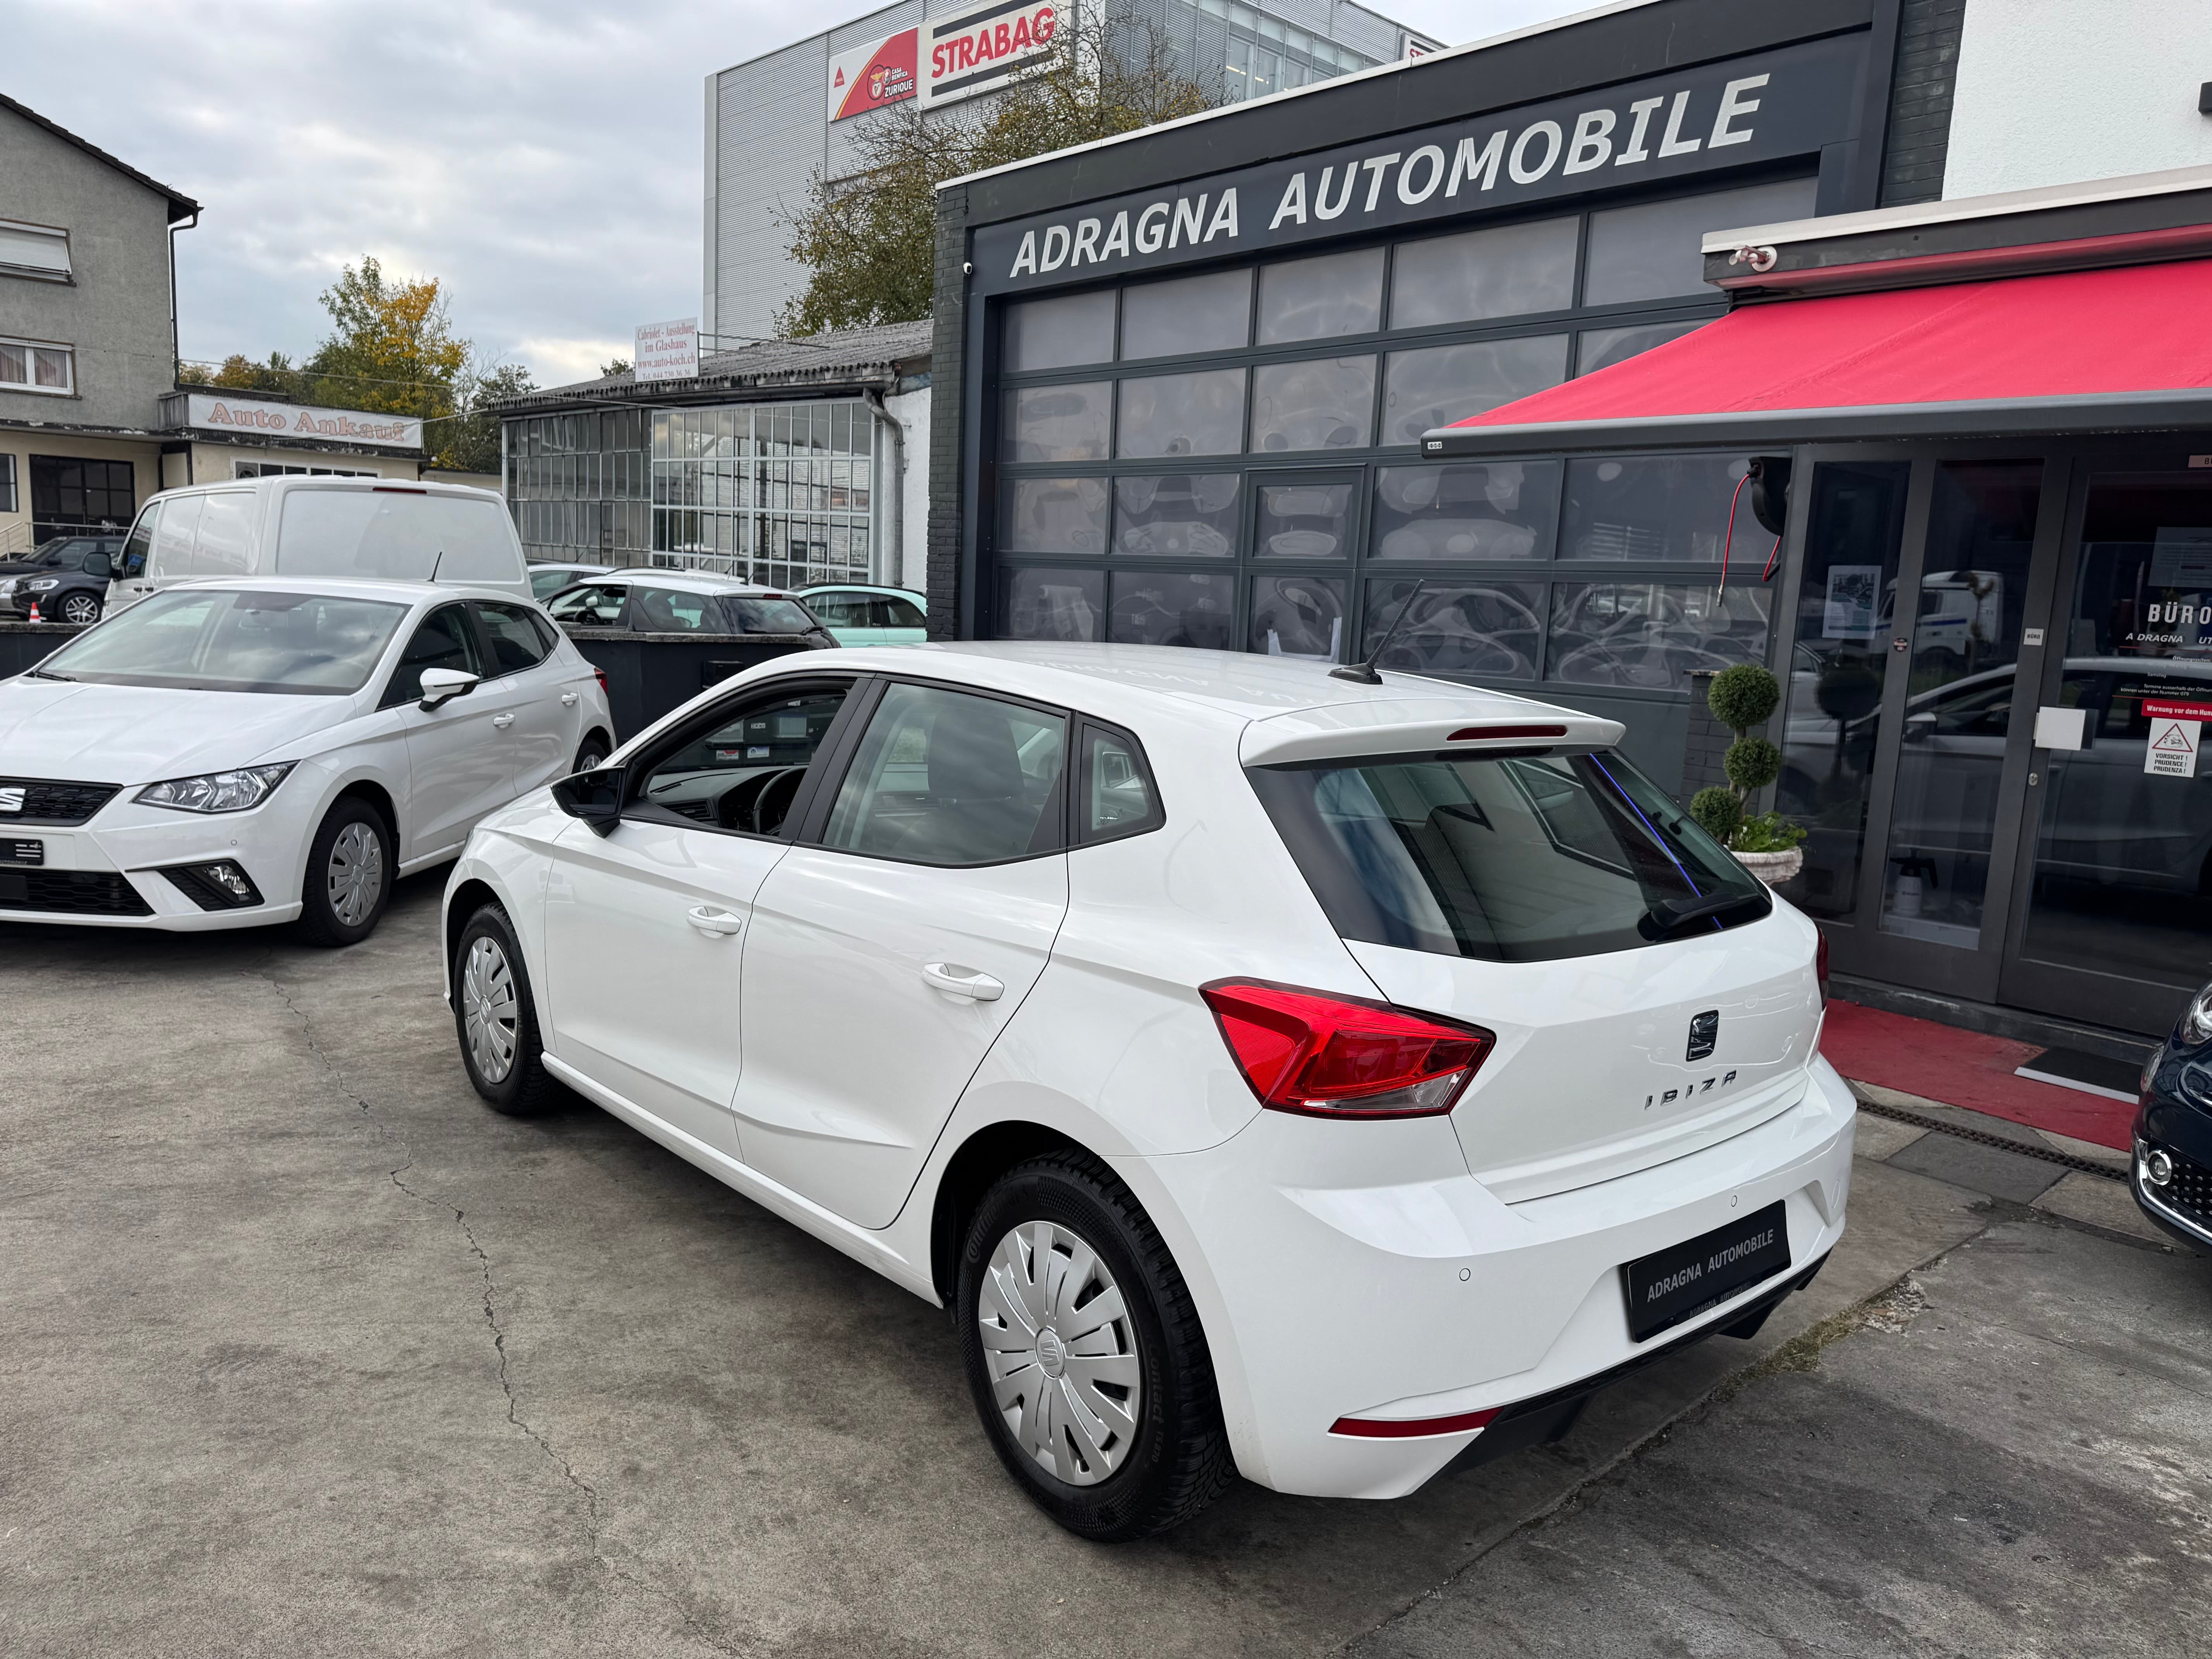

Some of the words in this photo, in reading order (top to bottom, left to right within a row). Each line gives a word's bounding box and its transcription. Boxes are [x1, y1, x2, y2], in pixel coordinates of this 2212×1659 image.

[931, 7, 1055, 78] STRABAG
[891, 70, 908, 81] BENFICA
[884, 79, 914, 98] ZURIQUE
[1010, 187, 1240, 278] ADRAGNA
[1269, 73, 1770, 230] AUTOMOBILE
[637, 327, 660, 341] Cabriolet
[666, 322, 695, 337] Ausstellung
[645, 342, 653, 353] im
[656, 338, 687, 352] Glashaus
[638, 352, 695, 369] www.auto-koch.ch
[208, 402, 286, 429] Auto
[294, 412, 405, 441] Ankauf
[2148, 601, 2212, 624] BÜRO
[2147, 704, 2173, 714] Warnung
[2155, 759, 2183, 767] PRUDENCE
[1644, 1069, 1737, 1110] IBIZA
[1647, 1262, 1702, 1303] ADRAGNA
[1708, 1229, 1774, 1273] AUTOMOBILE
